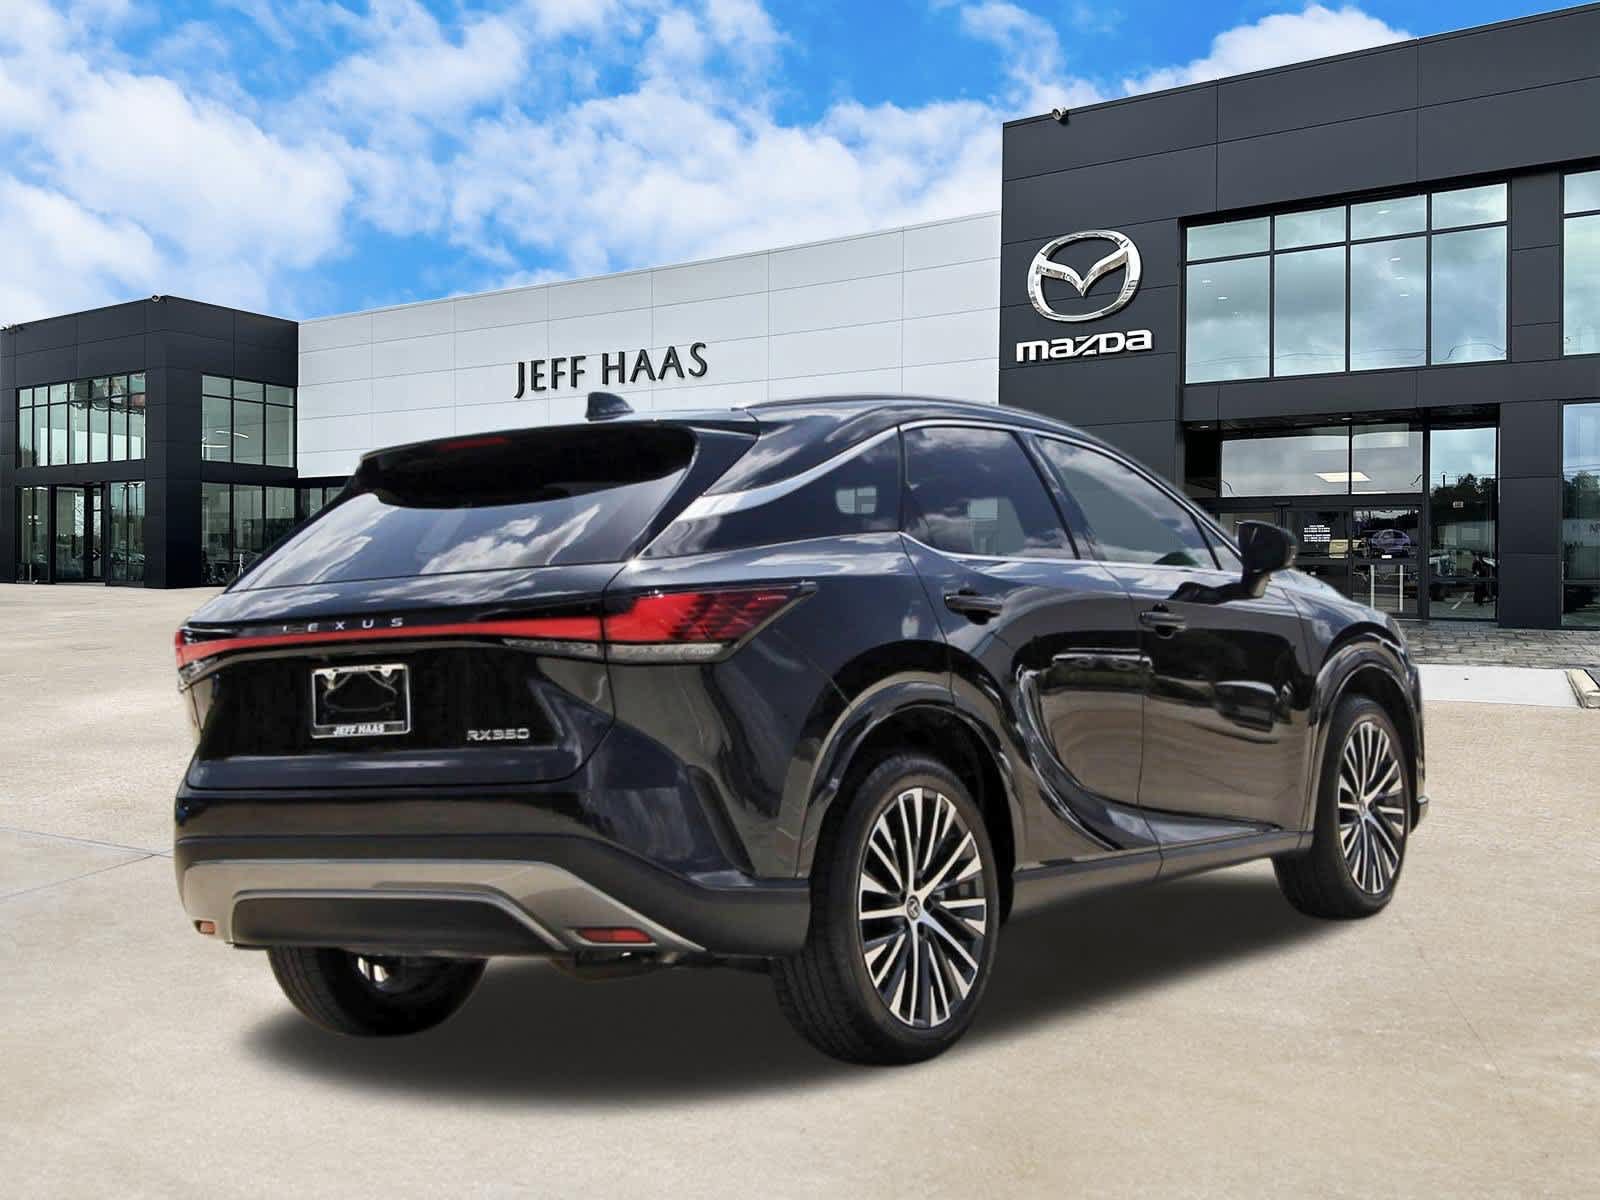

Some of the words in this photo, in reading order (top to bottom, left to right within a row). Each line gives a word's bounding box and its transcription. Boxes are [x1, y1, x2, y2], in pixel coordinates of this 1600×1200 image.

[514, 355, 586, 399] JEFF
[602, 342, 708, 386] HAAS
[282, 617, 403, 633] LEXUS
[333, 725, 357, 736] JEFF
[358, 723, 385, 735] HAAS
[466, 728, 529, 741] RX350
